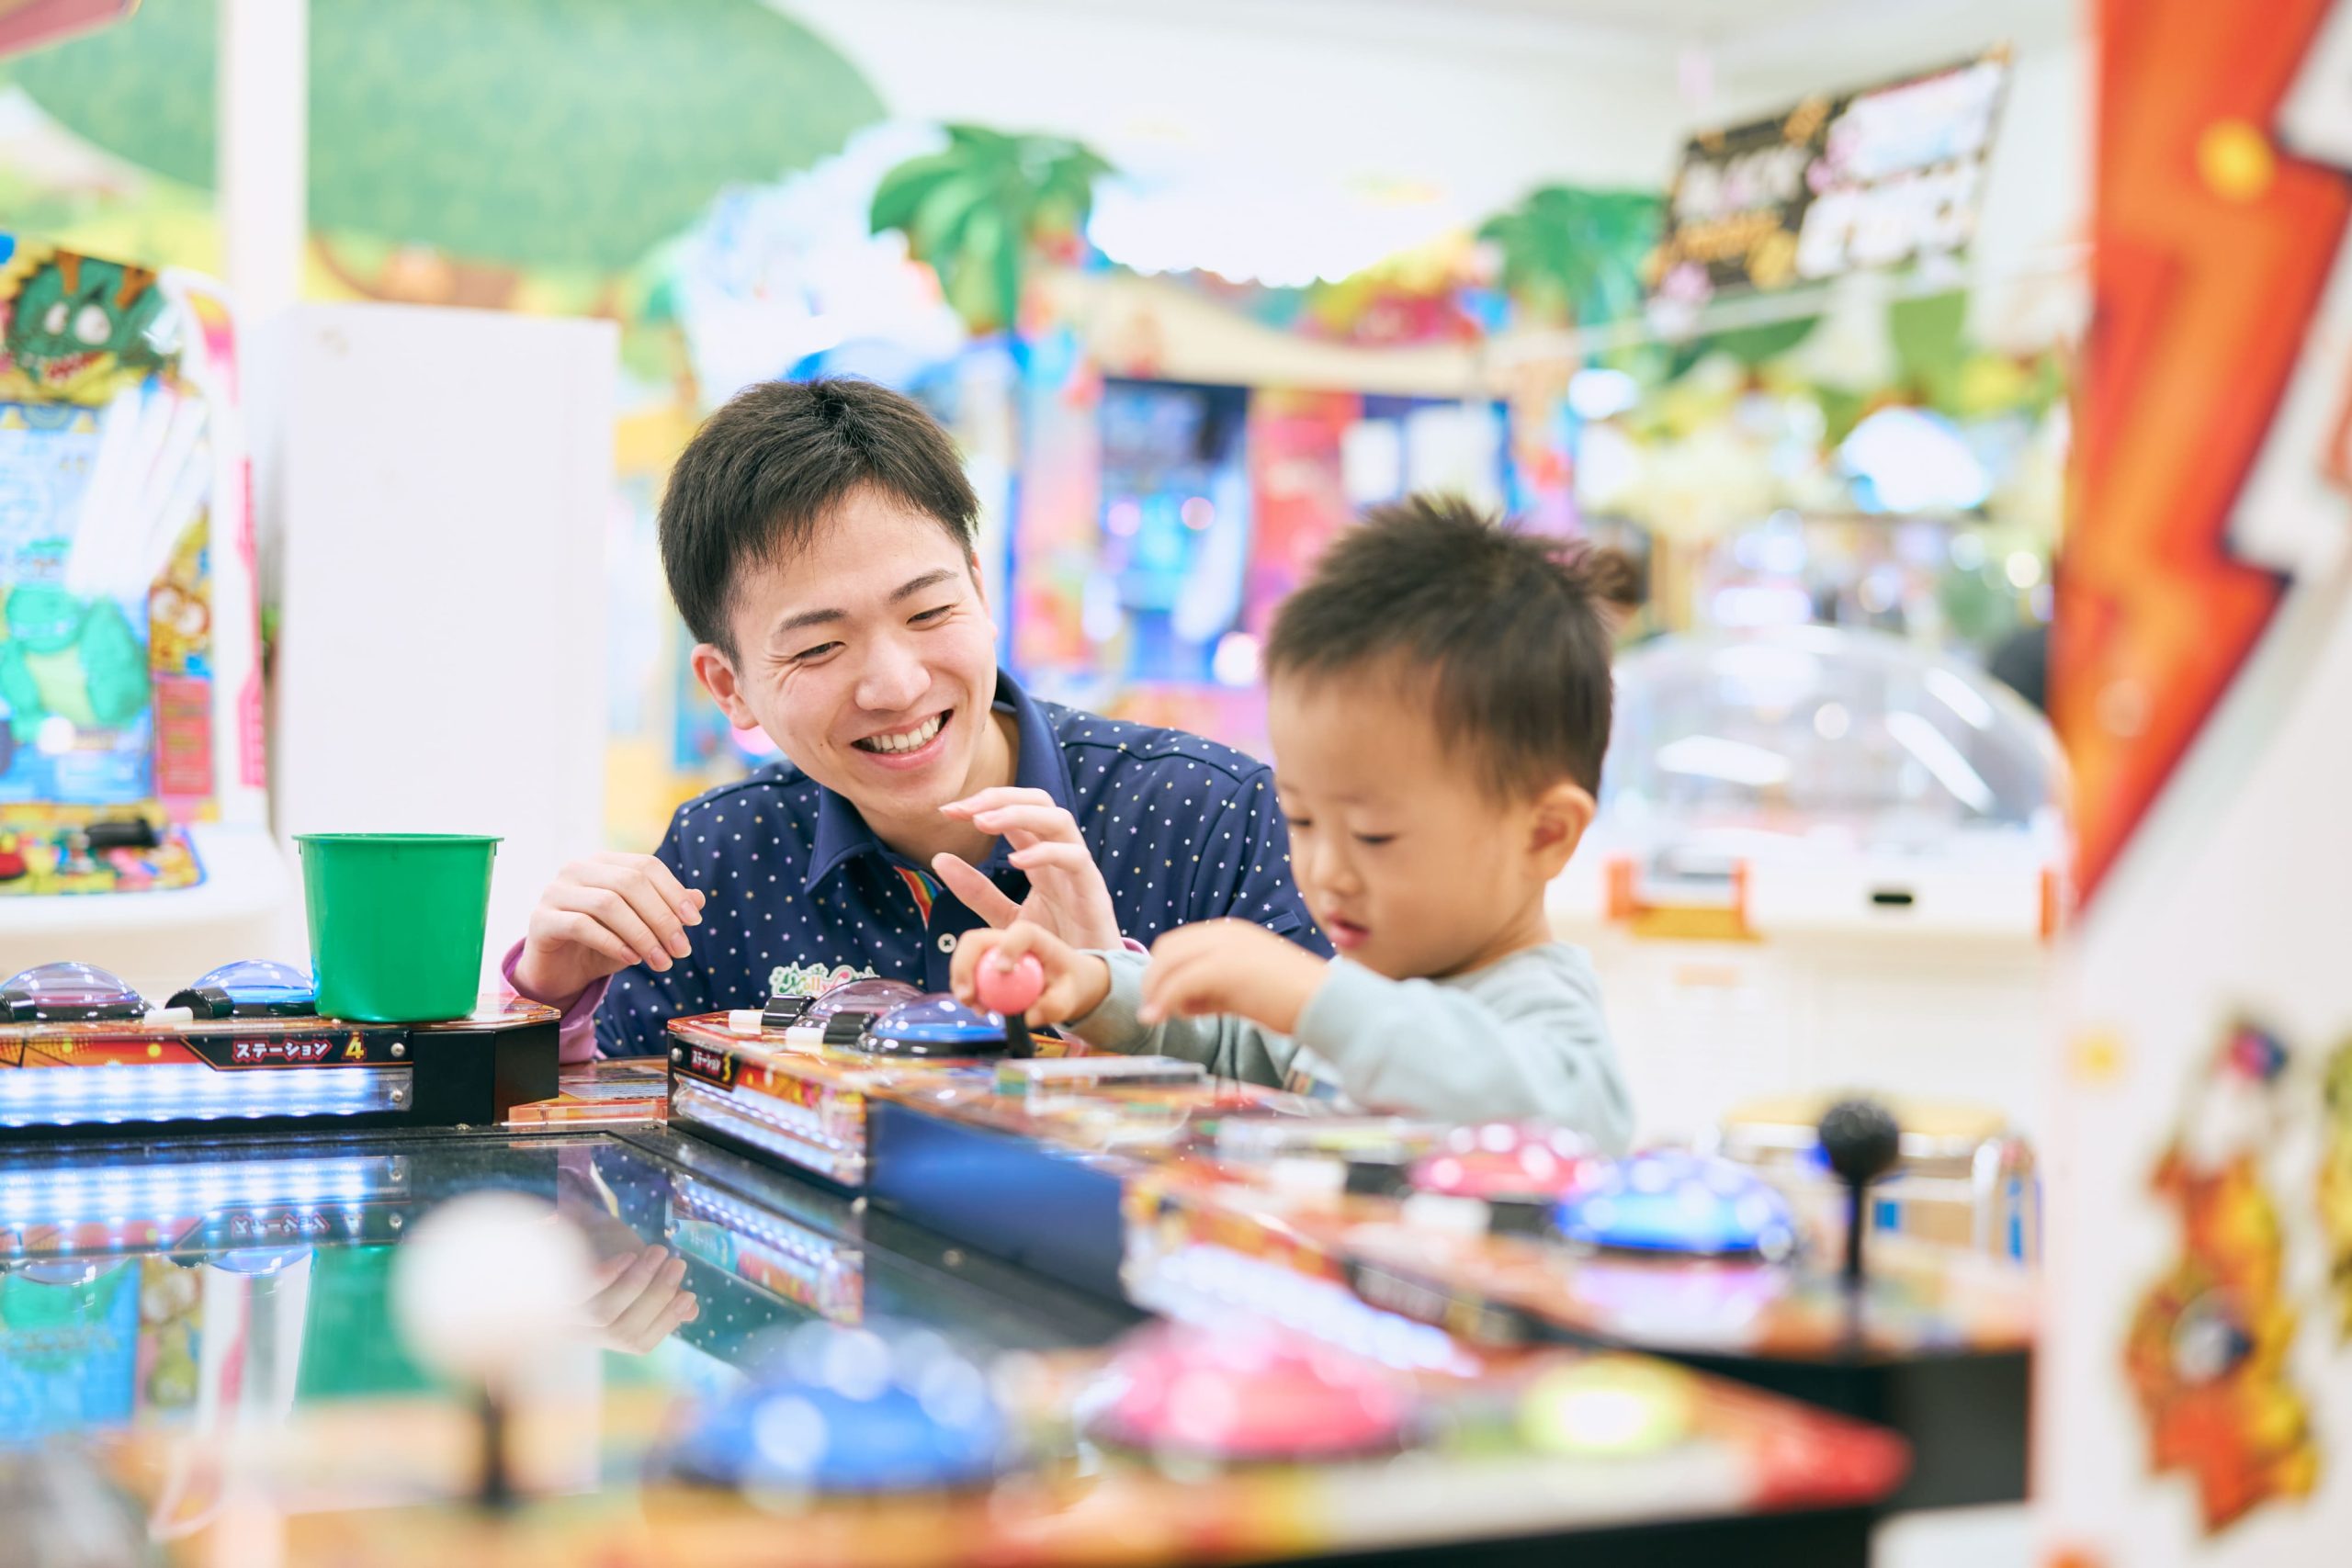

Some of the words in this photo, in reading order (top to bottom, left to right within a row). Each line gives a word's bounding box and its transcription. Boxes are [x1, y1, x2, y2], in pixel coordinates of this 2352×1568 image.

[236, 1042, 328, 1059] ステーション
[345, 1034, 365, 1060] 4
